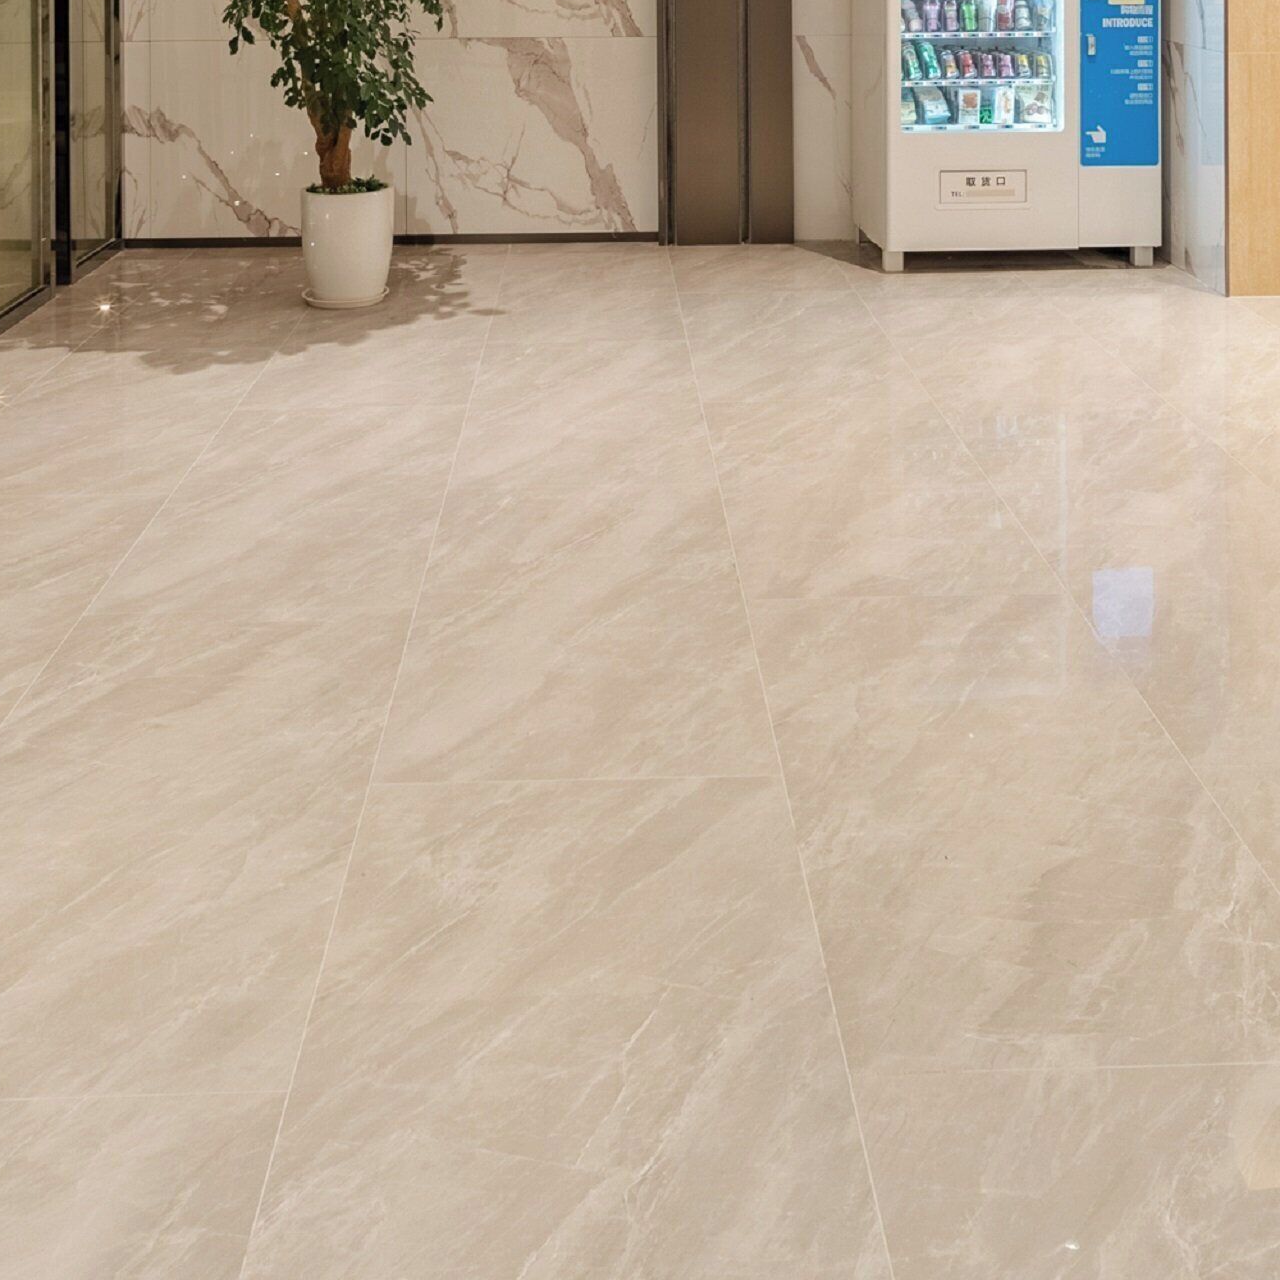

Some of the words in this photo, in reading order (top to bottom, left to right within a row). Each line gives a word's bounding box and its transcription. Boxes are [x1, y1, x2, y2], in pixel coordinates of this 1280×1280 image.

[1102, 17, 1154, 28] INTRODUCE
[965, 176, 1006, 187] 取货口
